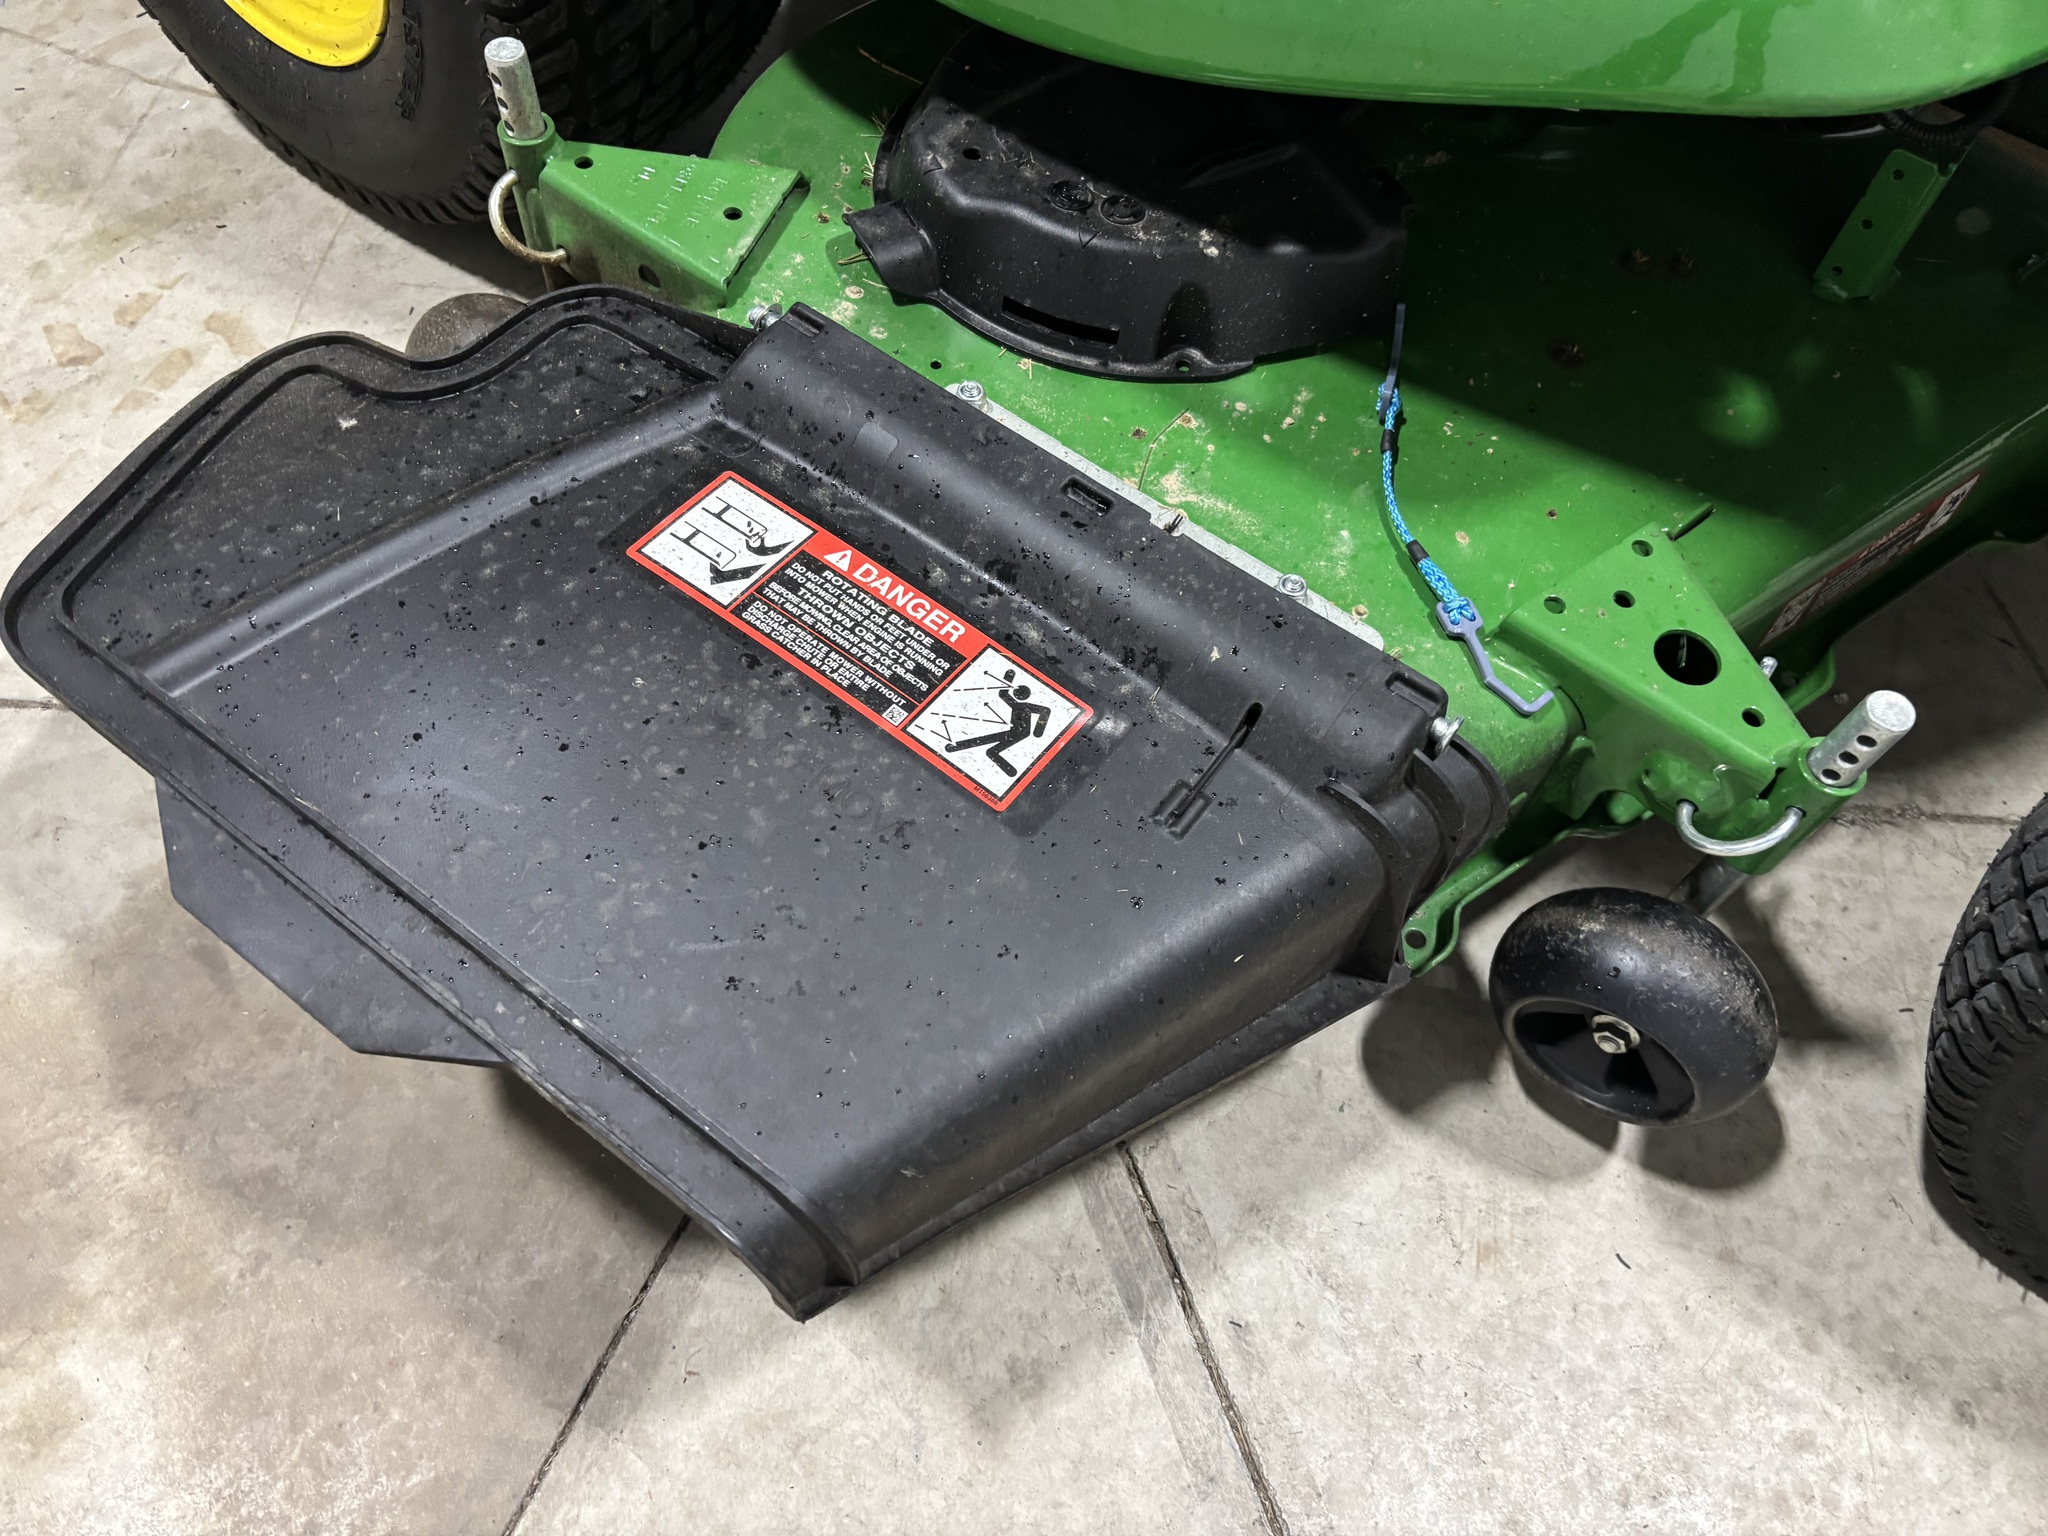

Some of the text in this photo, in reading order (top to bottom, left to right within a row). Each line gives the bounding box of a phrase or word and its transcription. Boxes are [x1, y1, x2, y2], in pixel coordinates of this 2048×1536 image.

[763, 588, 893, 677] THAT MAY BE THROWN BY BLADE
[769, 582, 928, 691] BEFORE MOWING, CLEAR AREA OF OBJECTS
[785, 568, 943, 676] INTO MOWER WHEN ENGINE IS RUNNING
[792, 562, 950, 670] DO NOT PUT HANDS OR FEET UNDER OR
[798, 588, 916, 670] THROWN OBJECTS
[822, 570, 934, 647] ROTATING BLADE
[852, 563, 965, 643] DANGER
[742, 612, 851, 687] GRASS CATCHER IN PLACE
[747, 606, 870, 691] DISCHARGE CHUTE OR ENTIRE
[753, 601, 906, 706] DO NOT OPERATE MOWER WITHOUT
